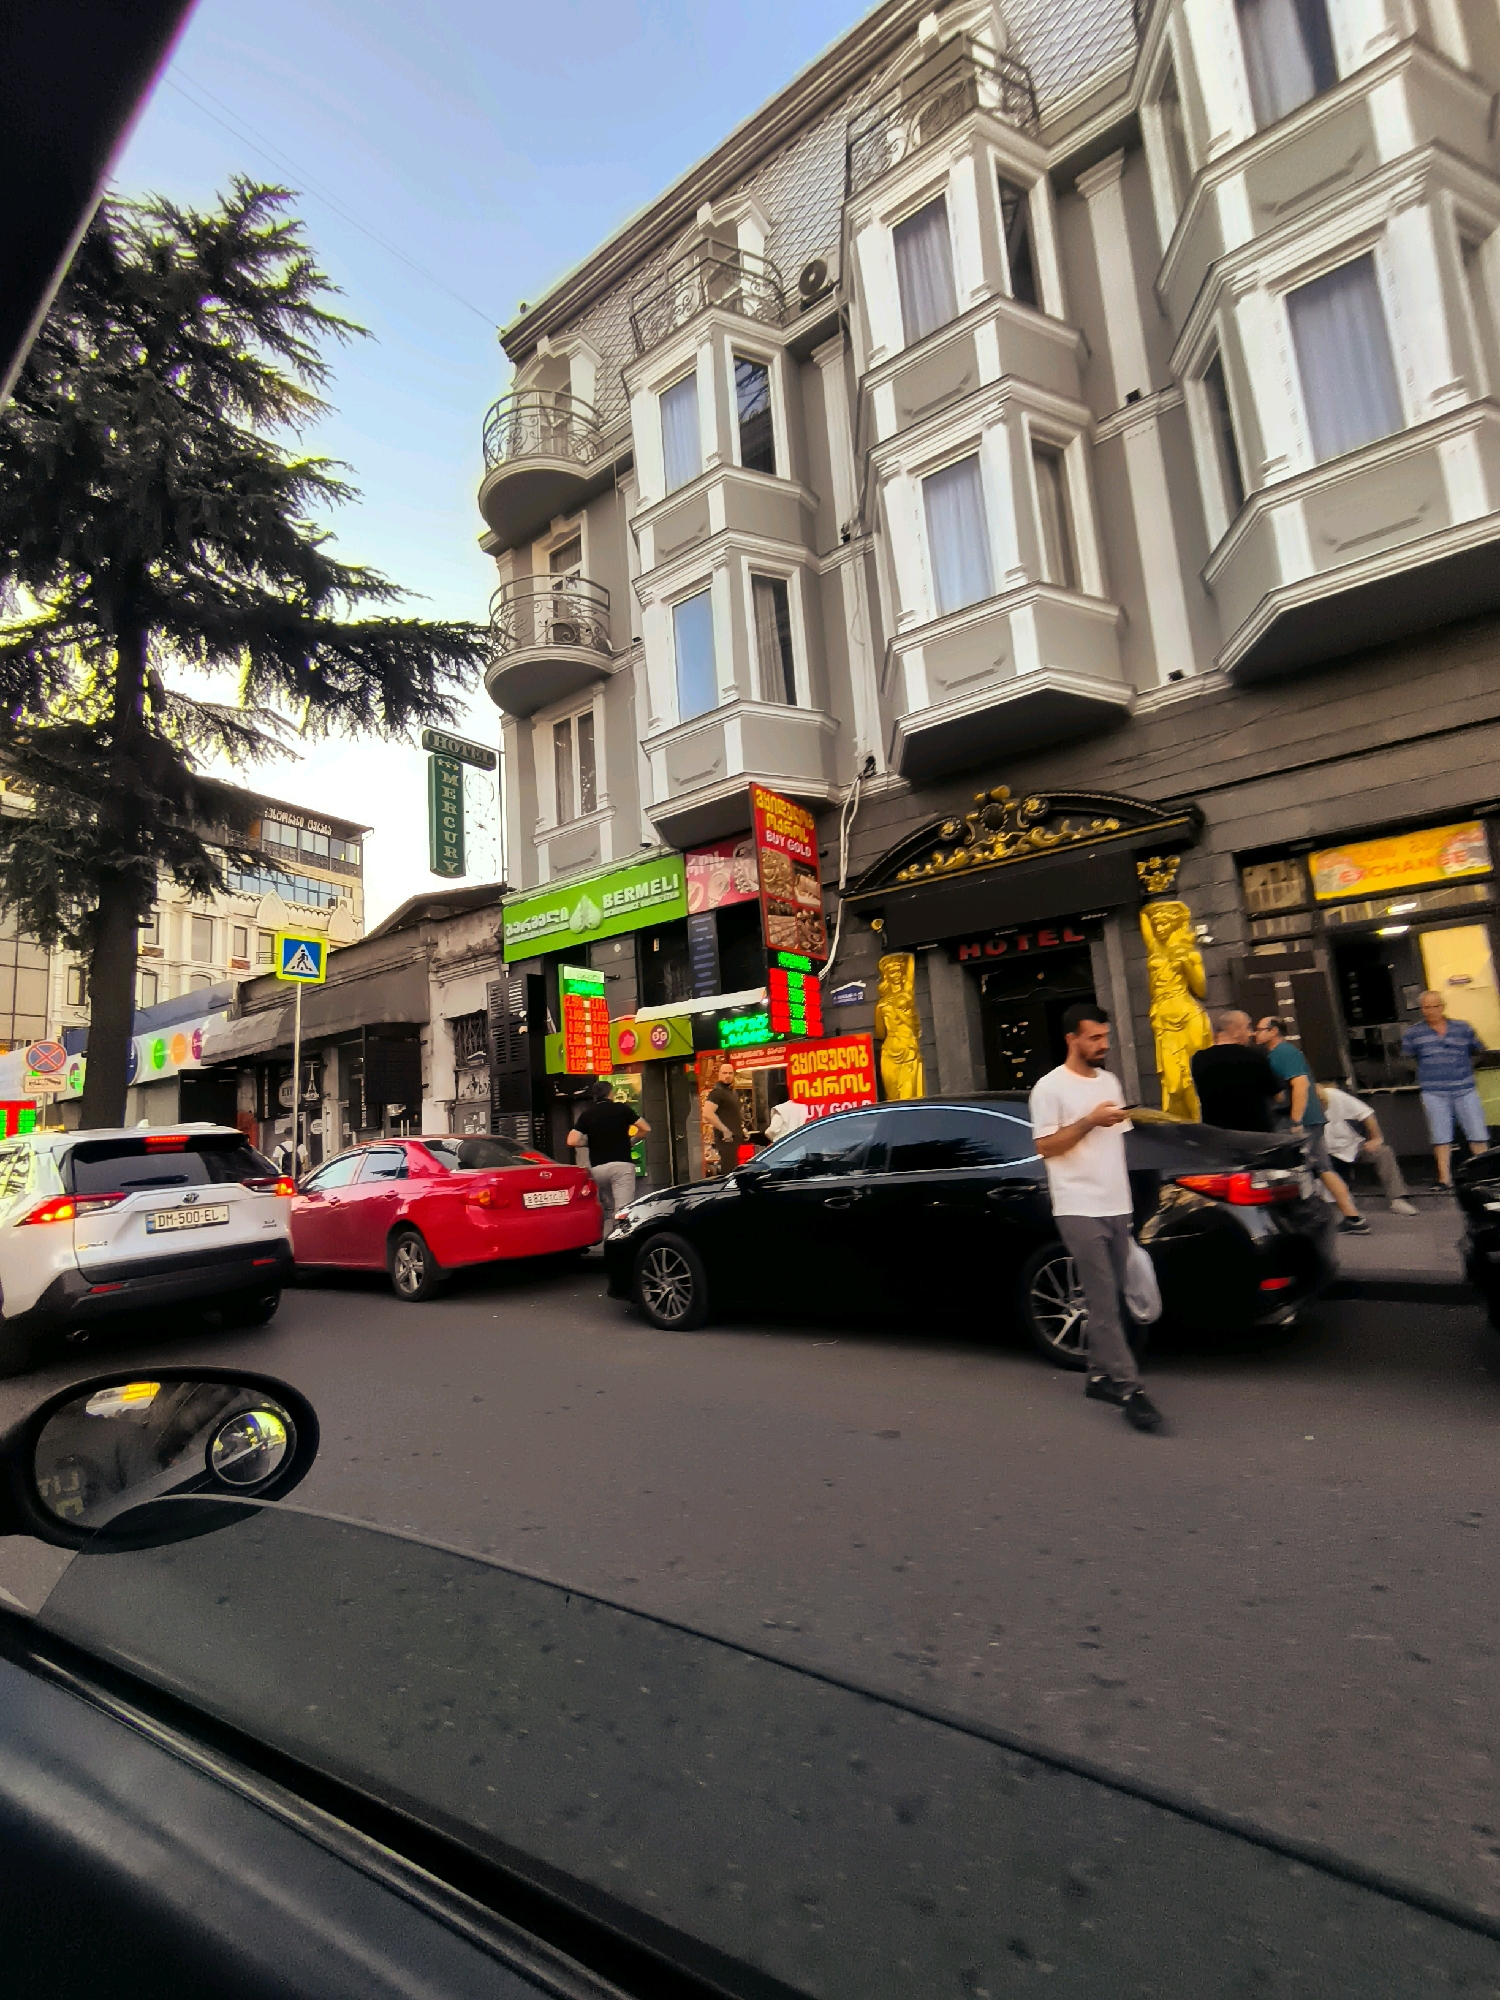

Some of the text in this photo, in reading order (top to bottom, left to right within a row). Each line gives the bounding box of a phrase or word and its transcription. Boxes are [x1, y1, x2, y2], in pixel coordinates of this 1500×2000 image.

[433, 733, 494, 763] HOTEL
[441, 770, 460, 873] MERCURY
[765, 829, 812, 857] BUY GOLD
[602, 873, 679, 909] BERMELI
[958, 928, 1086, 961] HOTEL
[806, 1103, 825, 1119] UY
[158, 1209, 220, 1228] DM-500-EL
